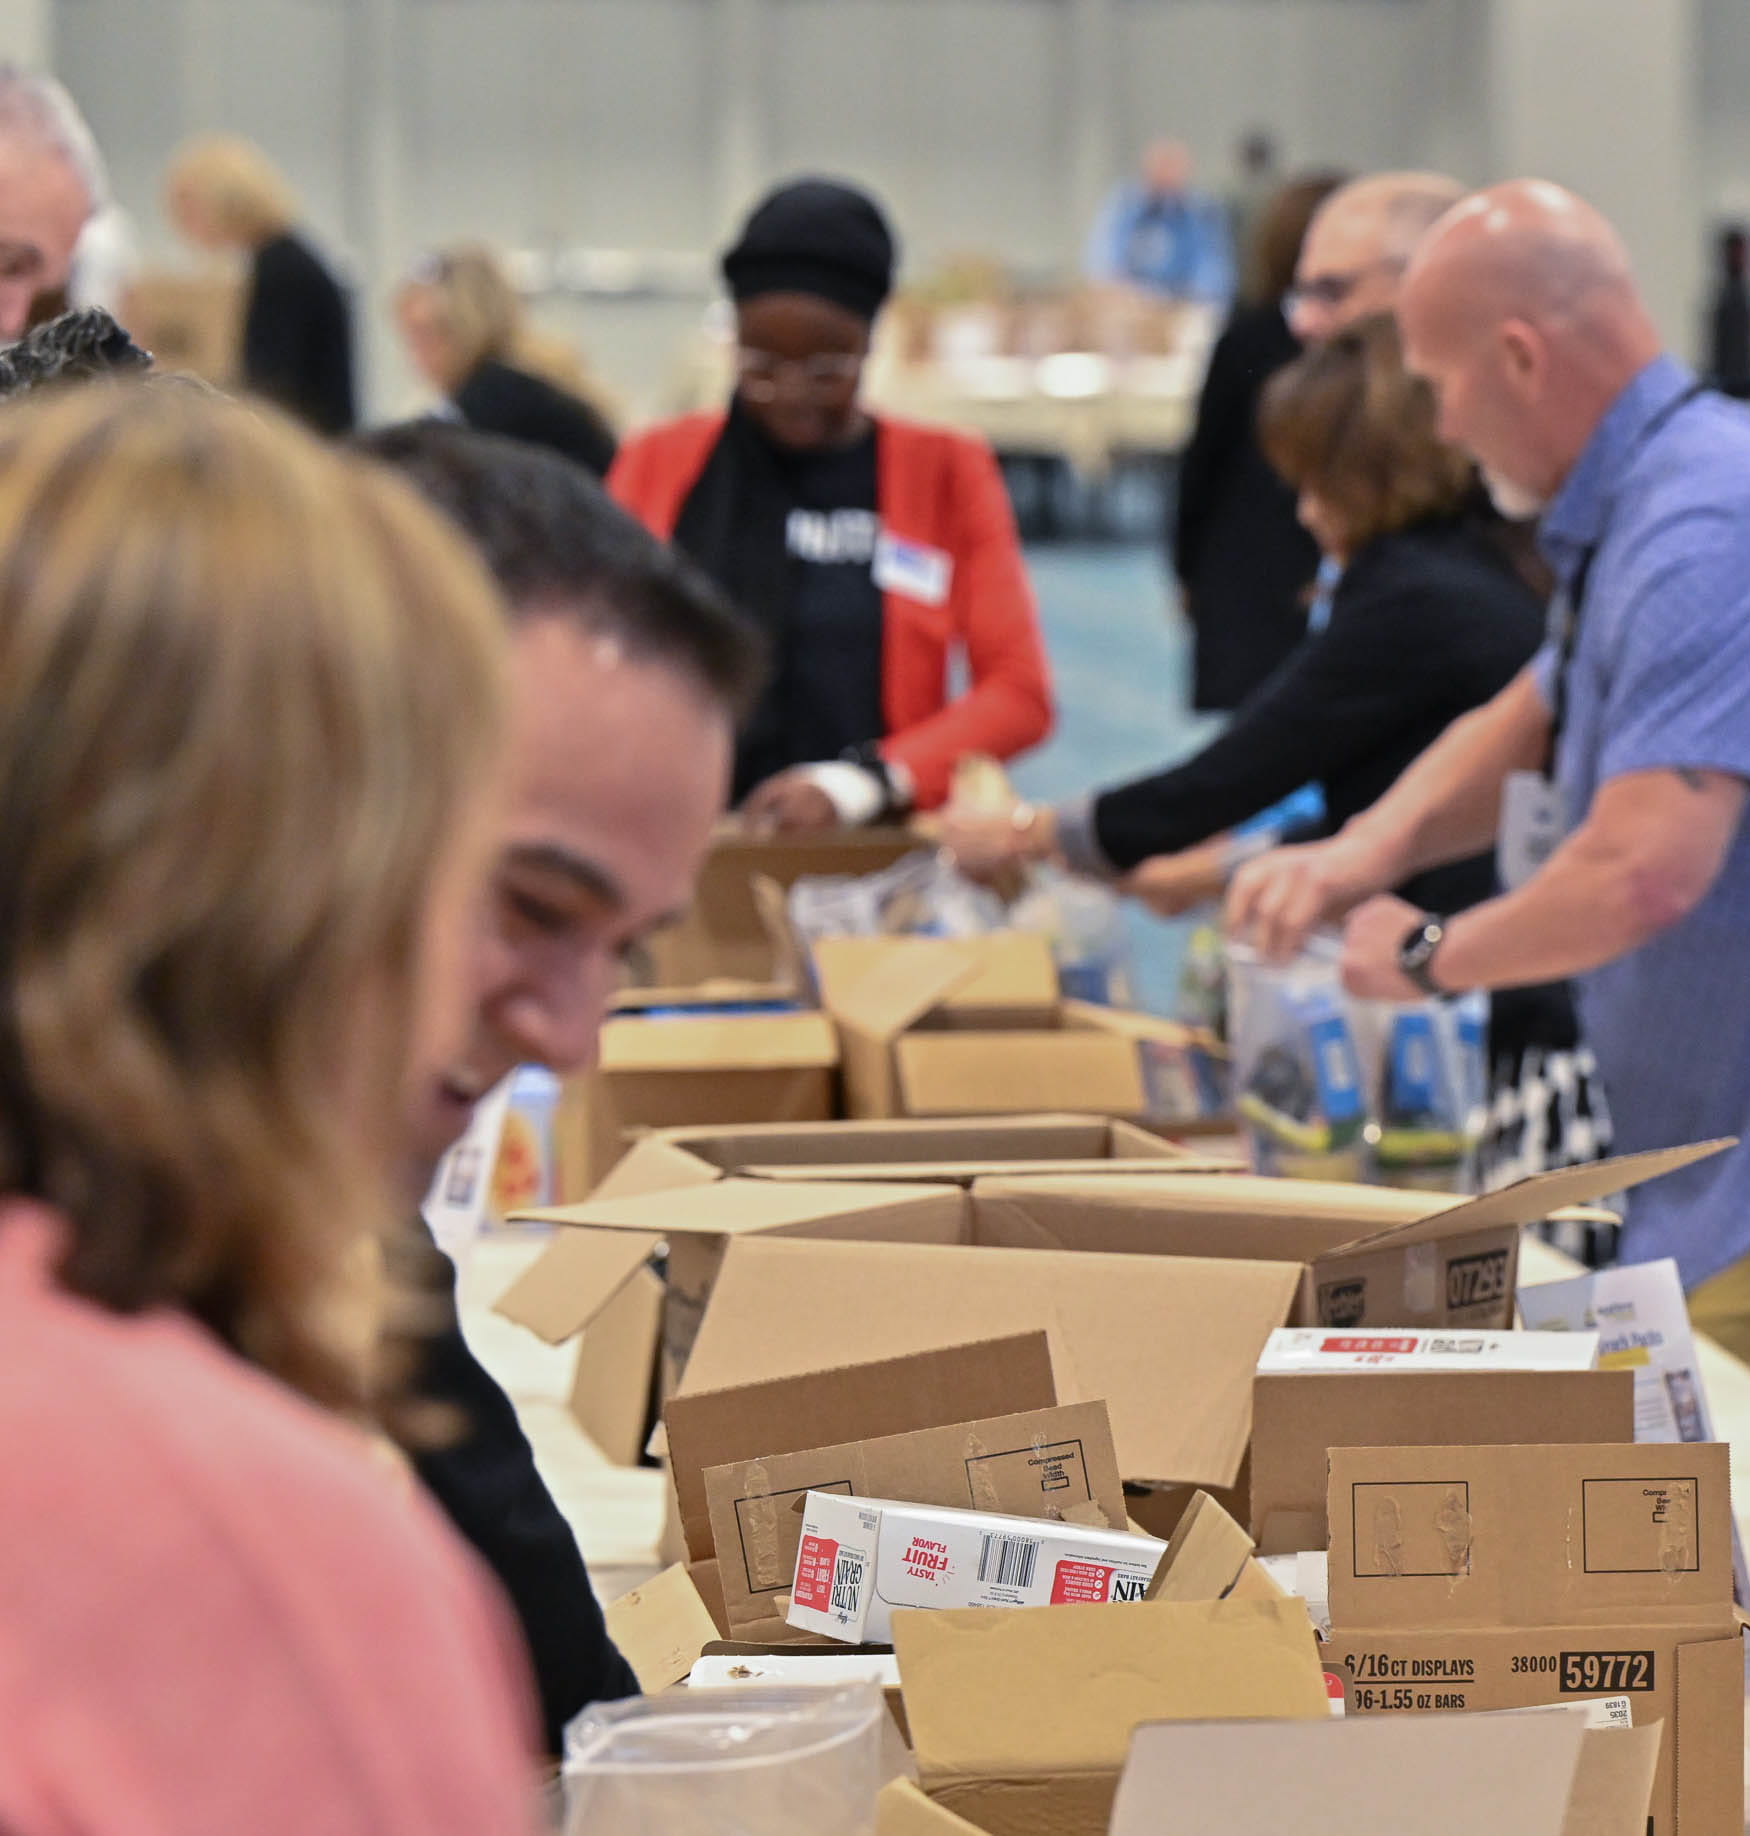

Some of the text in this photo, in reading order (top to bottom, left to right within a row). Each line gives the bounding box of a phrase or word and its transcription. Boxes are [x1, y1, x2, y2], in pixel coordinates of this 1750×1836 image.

[1027, 1452, 1075, 1466] Compressed
[912, 1536, 947, 1554] FLAVOR
[901, 1547, 949, 1571] FRUIT
[833, 1558, 862, 1585] GRAIN
[906, 1566, 936, 1581] TASTY
[831, 1584, 860, 1613] NUTRI
[1113, 1580, 1149, 1601] AIN
[1345, 1654, 1474, 1677] 6/16 CT DISPLAYS
[1511, 1655, 1649, 1689] 38000 59772
[1356, 1689, 1465, 1709] 96-1.55 OZ BARS
